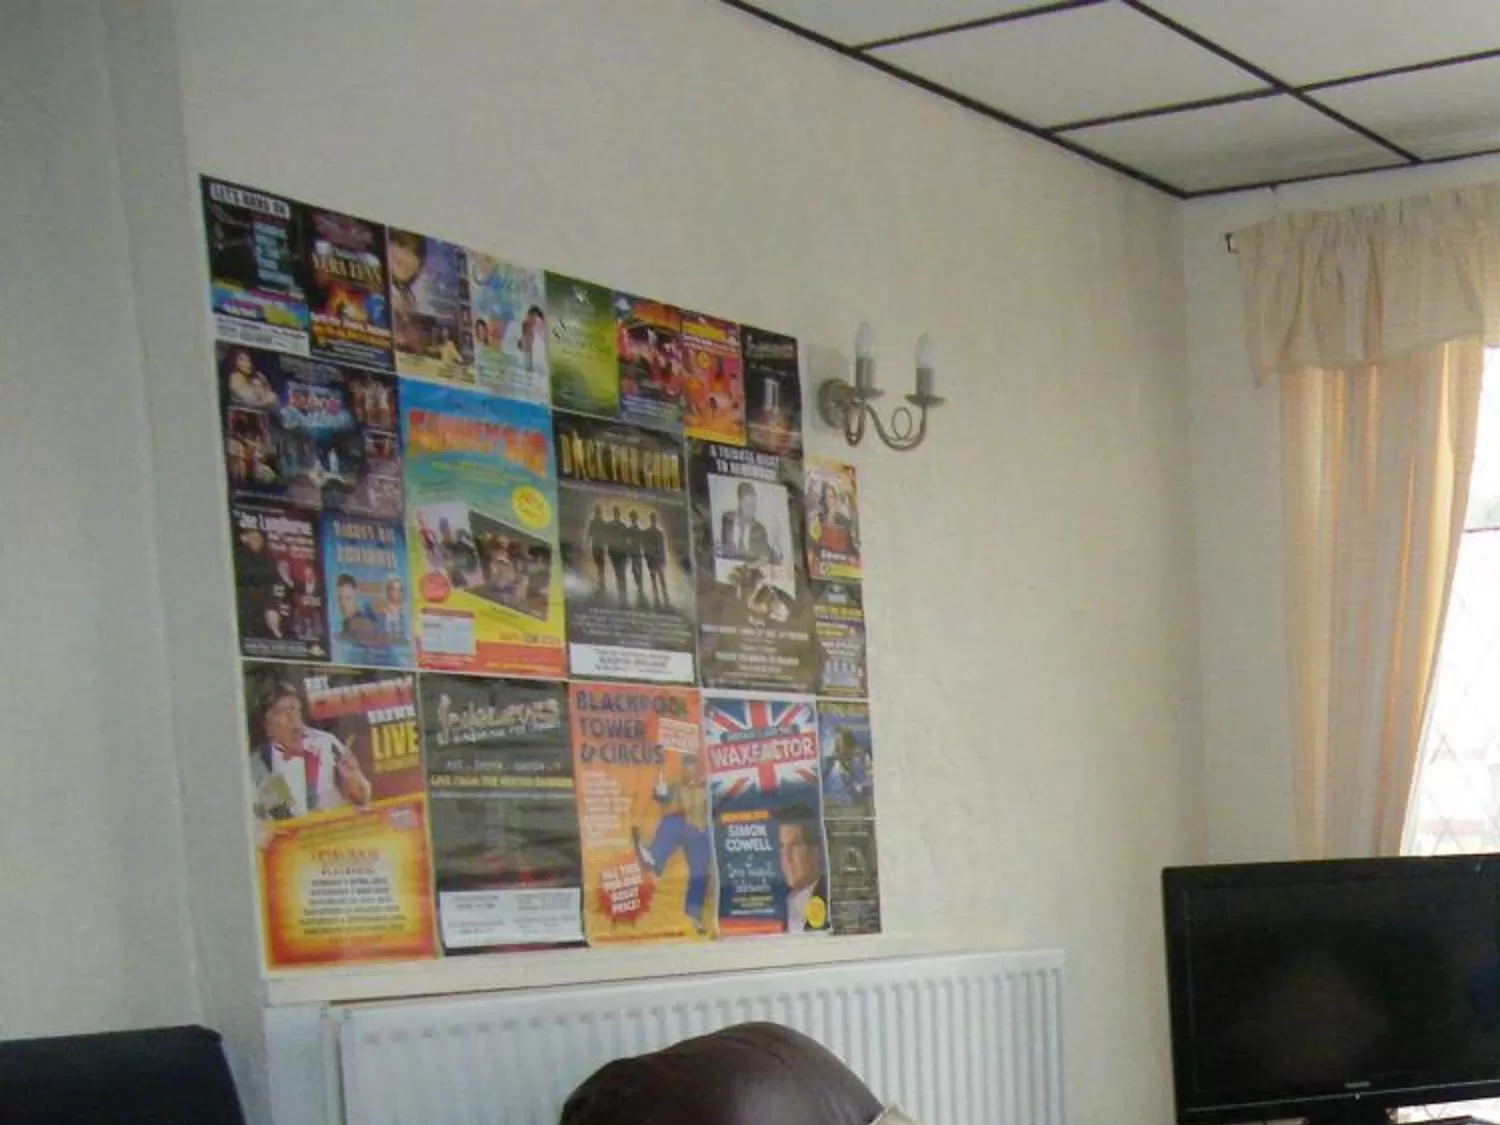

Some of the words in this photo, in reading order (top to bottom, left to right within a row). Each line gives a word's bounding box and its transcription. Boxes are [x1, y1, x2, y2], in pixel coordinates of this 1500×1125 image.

[371, 720, 419, 760] LIVE
[579, 717, 645, 740] TOWER
[600, 743, 664, 766] CIRCUS
[725, 837, 773, 852] COWELL
